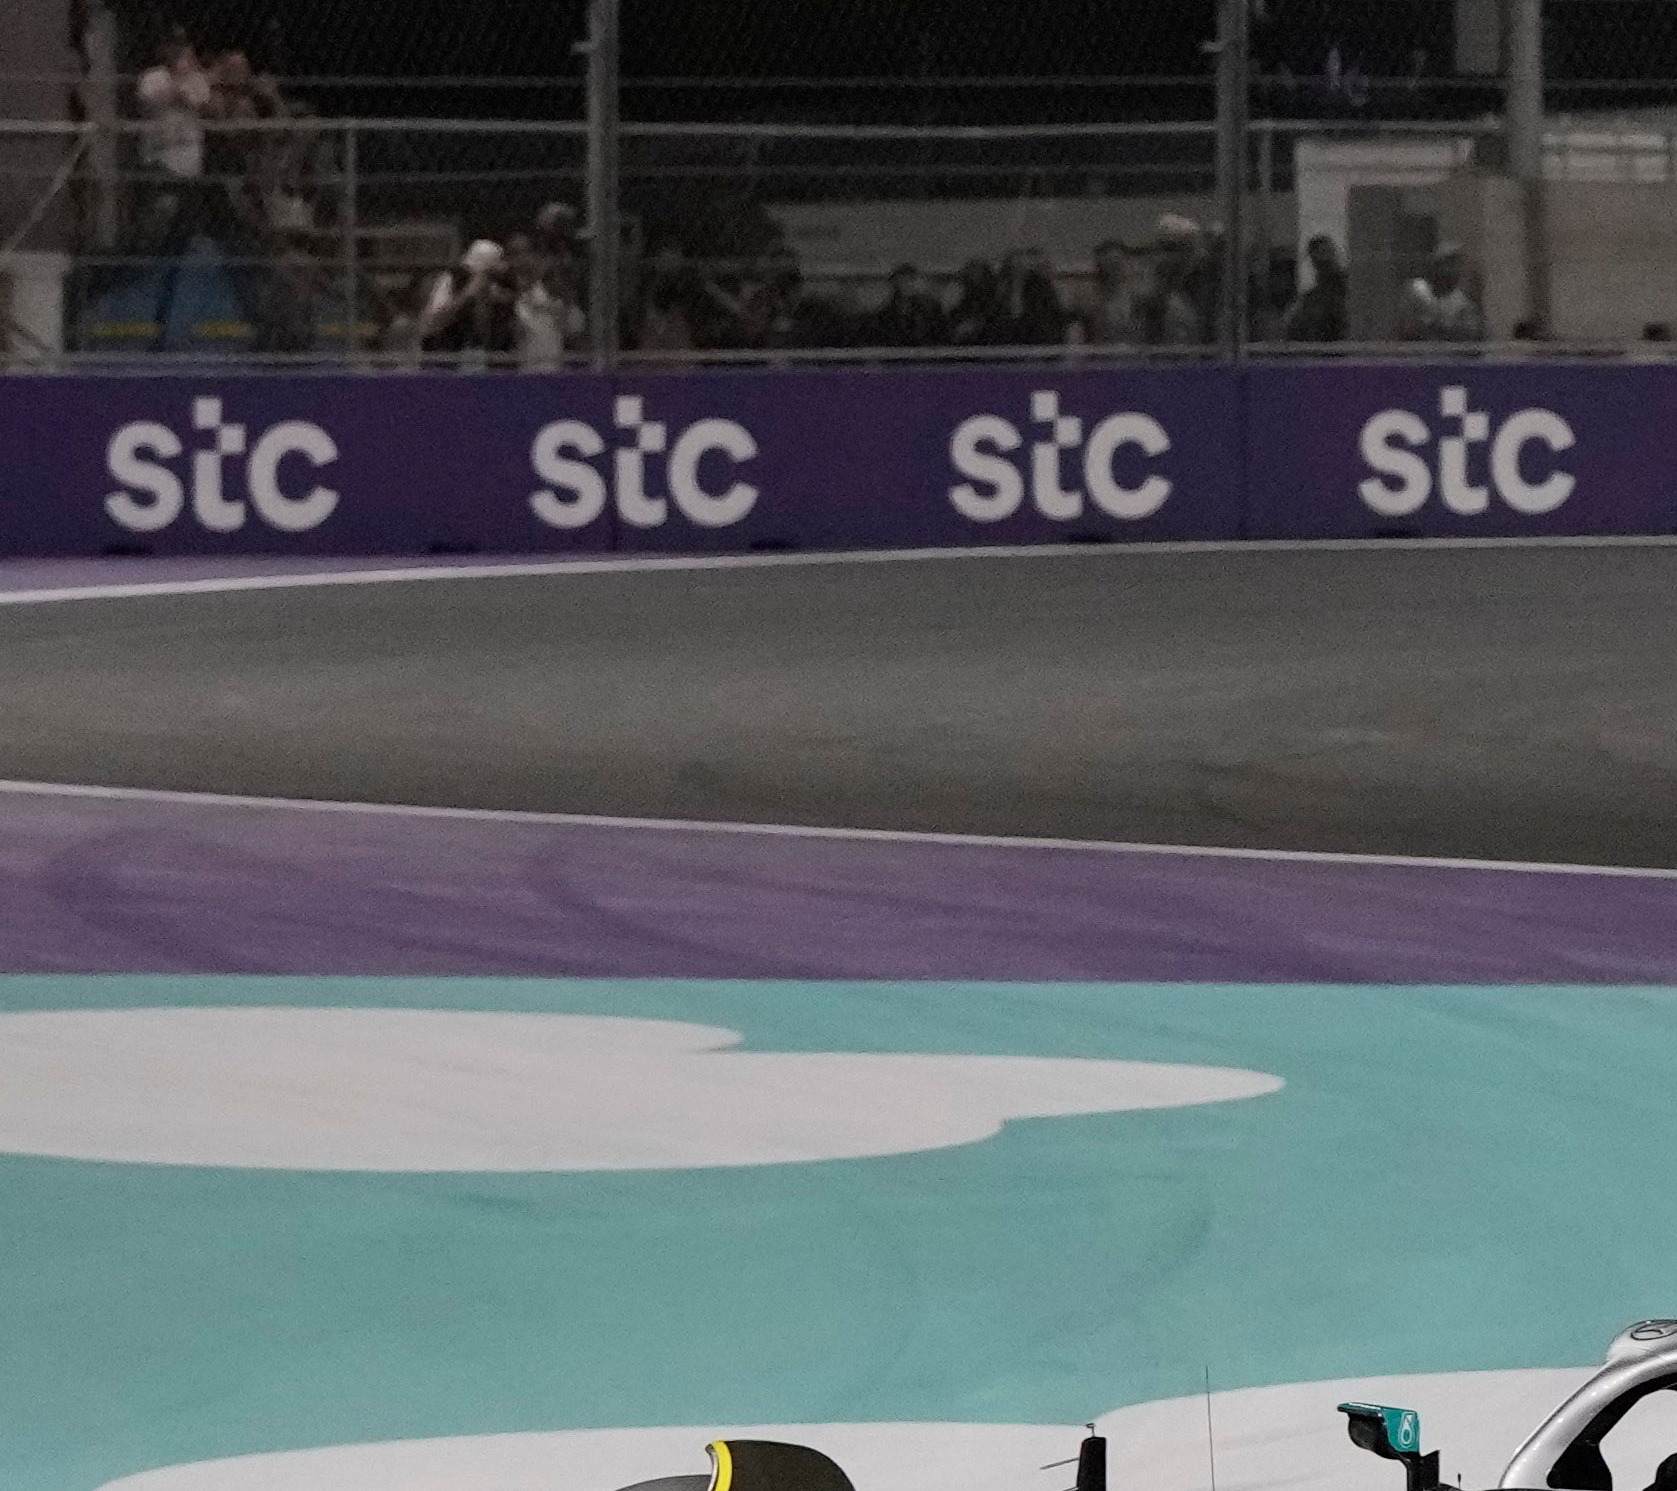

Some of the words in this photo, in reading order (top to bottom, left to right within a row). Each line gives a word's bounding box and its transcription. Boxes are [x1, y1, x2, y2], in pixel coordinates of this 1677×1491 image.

[108, 399, 336, 529] stc
[533, 398, 756, 526] stc
[952, 393, 1169, 519] stc
[1361, 388, 1573, 513] stc
